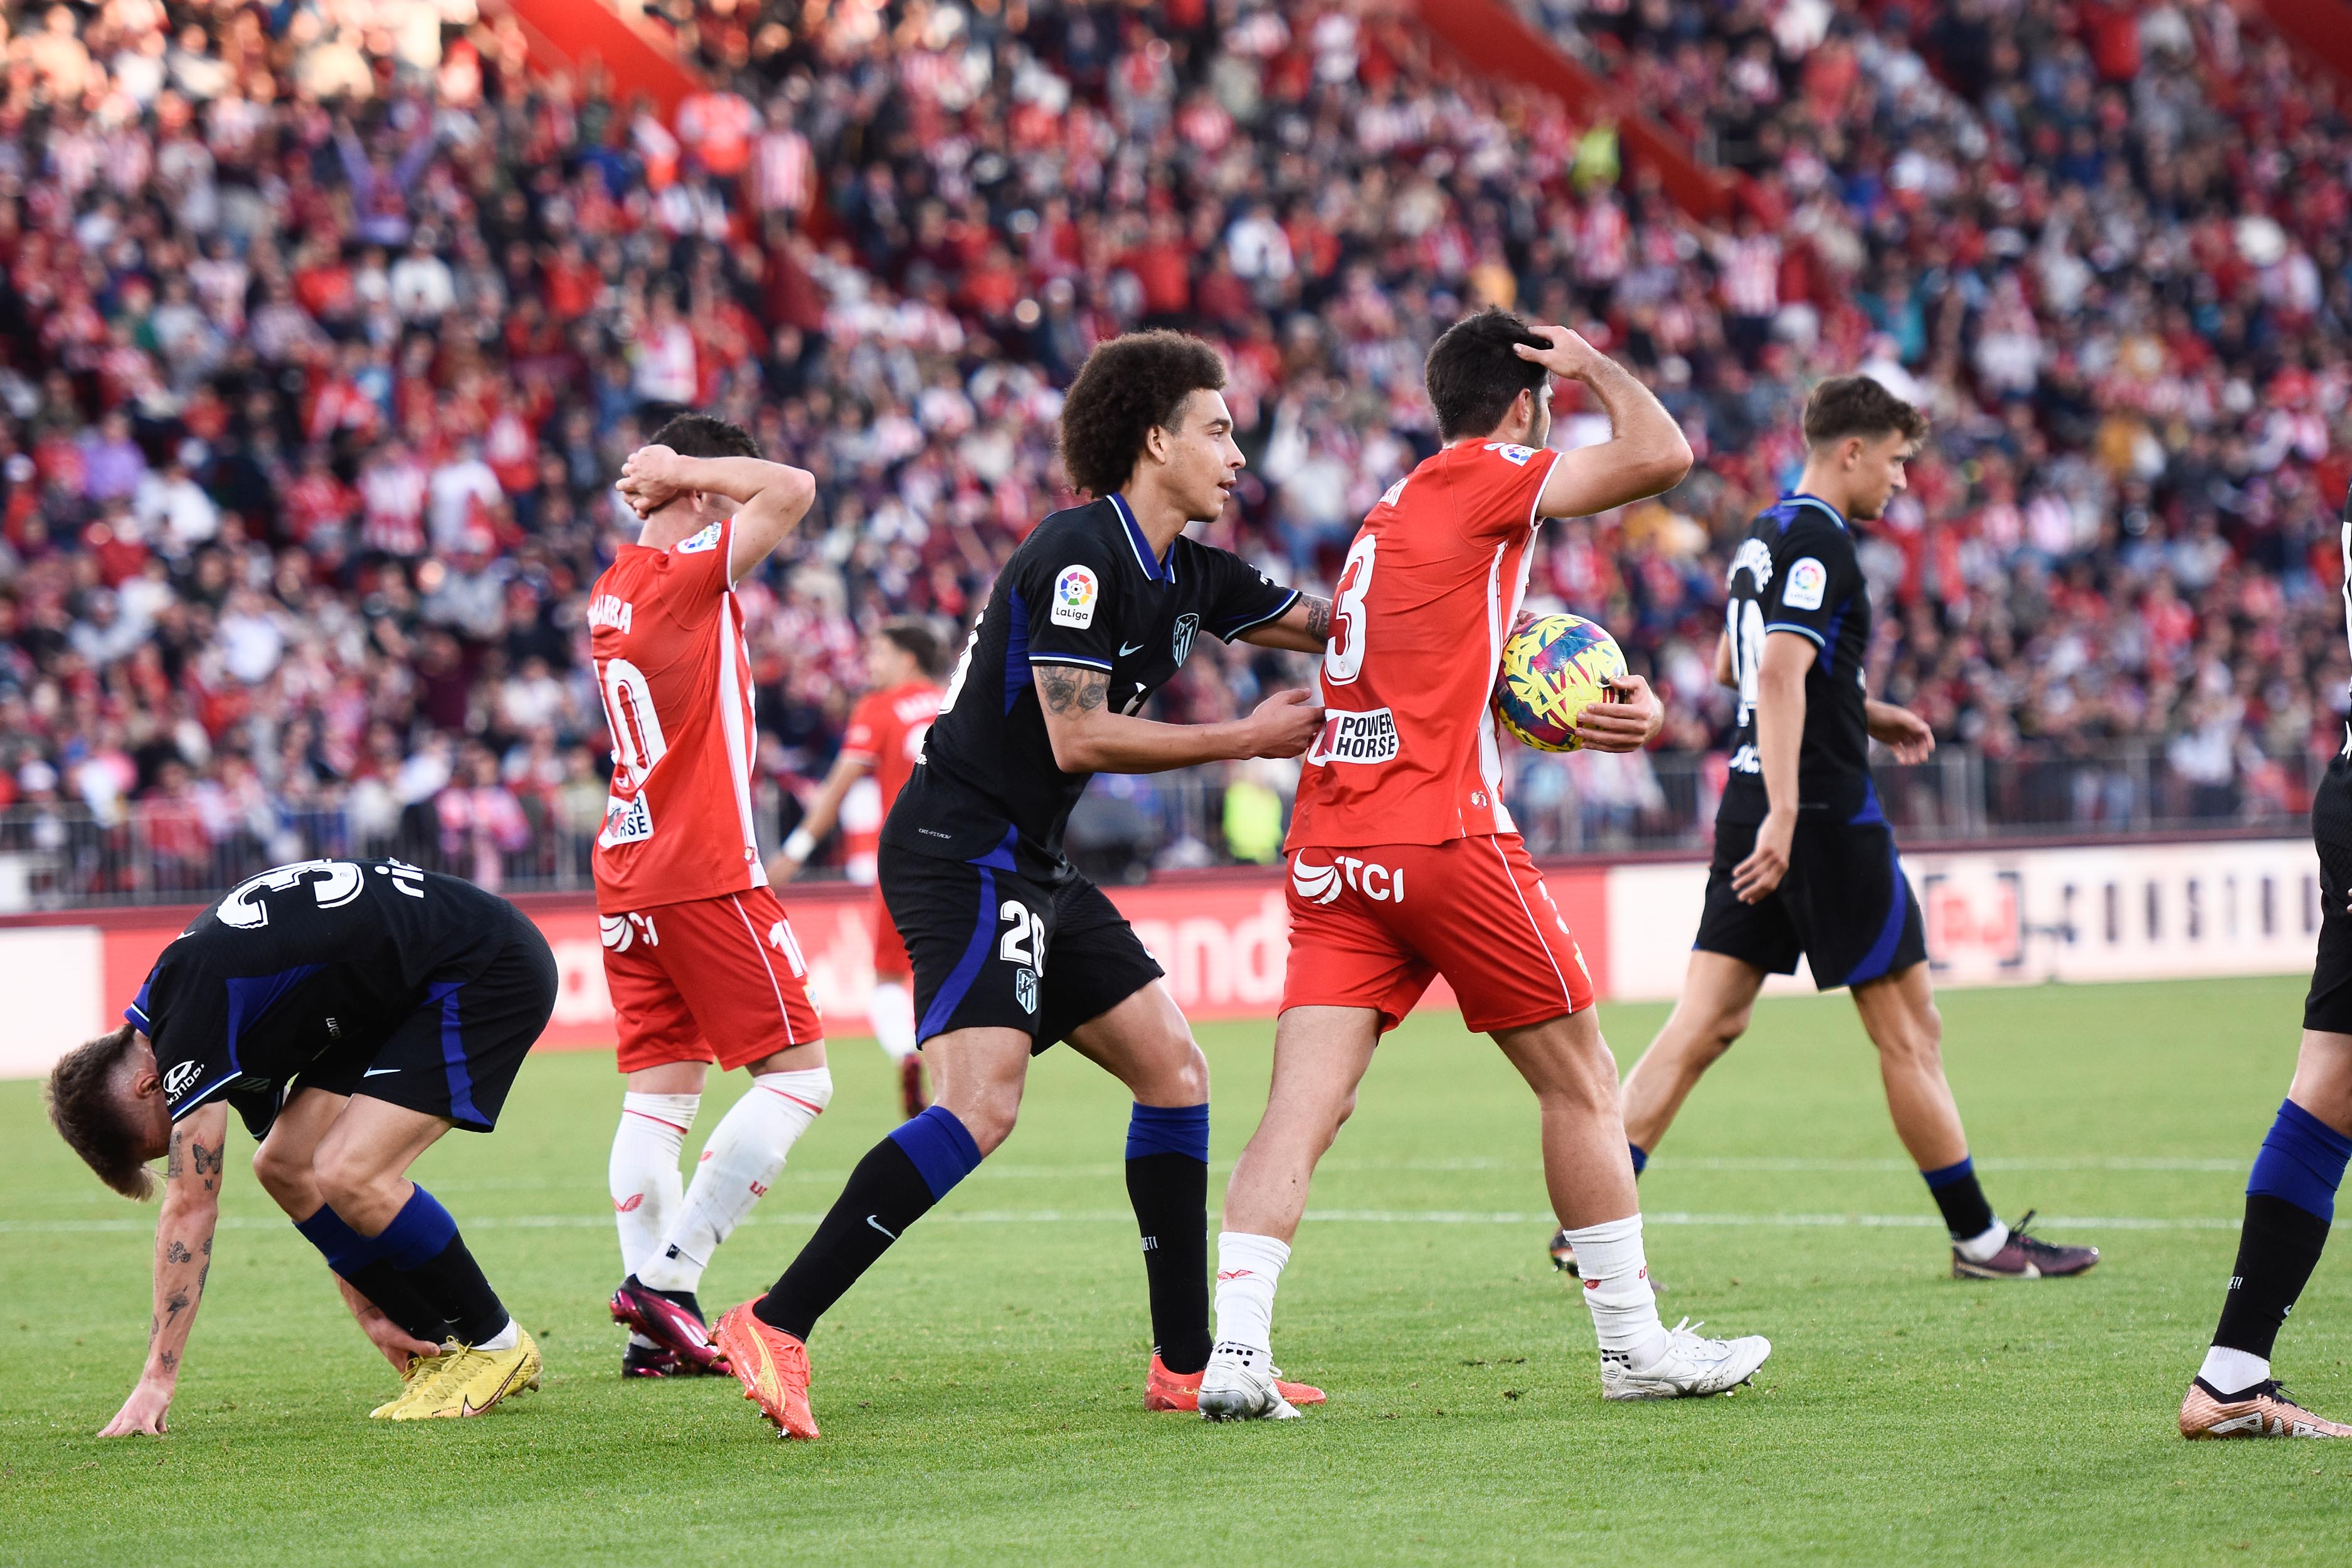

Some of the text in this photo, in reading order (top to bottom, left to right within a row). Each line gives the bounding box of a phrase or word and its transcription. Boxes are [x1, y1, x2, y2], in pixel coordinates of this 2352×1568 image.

[1056, 607, 1089, 621] LaLiga
[1325, 534, 1377, 686] 3
[1340, 712, 1394, 738] POWER
[1336, 734, 1396, 758] HORSE
